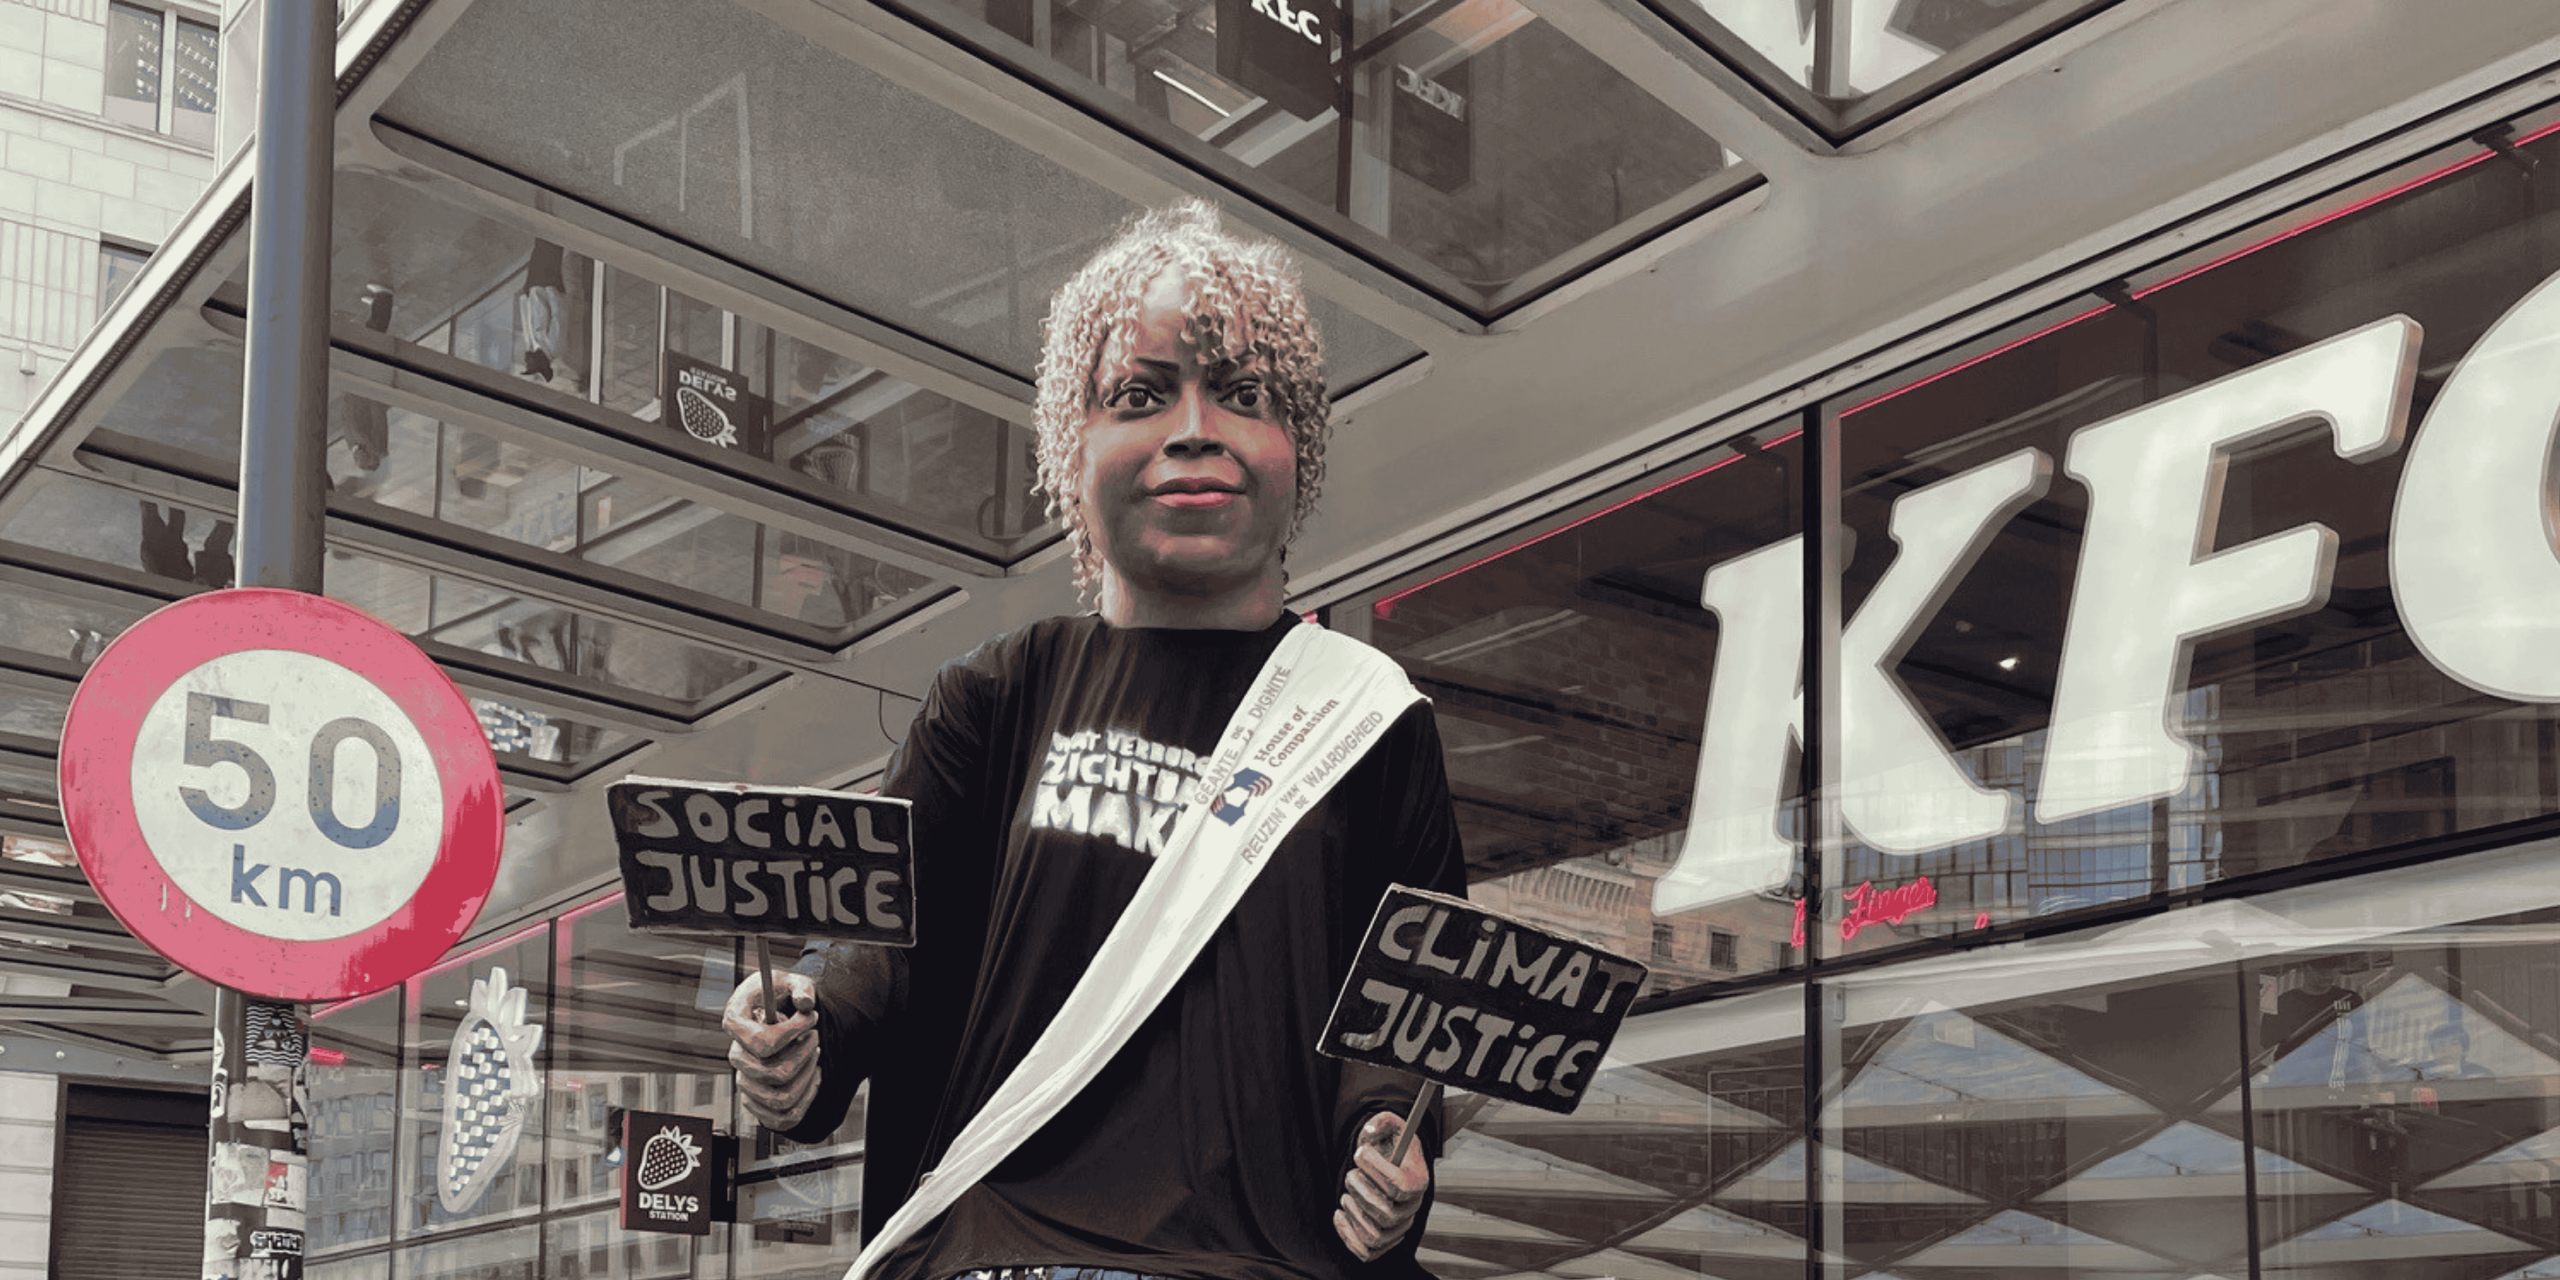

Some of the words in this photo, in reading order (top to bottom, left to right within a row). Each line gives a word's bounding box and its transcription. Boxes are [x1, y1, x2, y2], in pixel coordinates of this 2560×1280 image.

[1253, 722, 1295, 763] House
[1292, 704, 1309, 721] of
[1268, 698, 1340, 768] Compassion
[179, 690, 402, 850] 50
[1240, 808, 1287, 864] REUZIN
[1279, 784, 1301, 805] VAN
[1294, 794, 1310, 809] DE
[1302, 710, 1384, 787] WAARDIGHEID
[1031, 784, 1187, 858] MAK
[231, 843, 342, 916] km
[638, 1191, 700, 1214] DELYS
[649, 1210, 689, 1222] STATION
